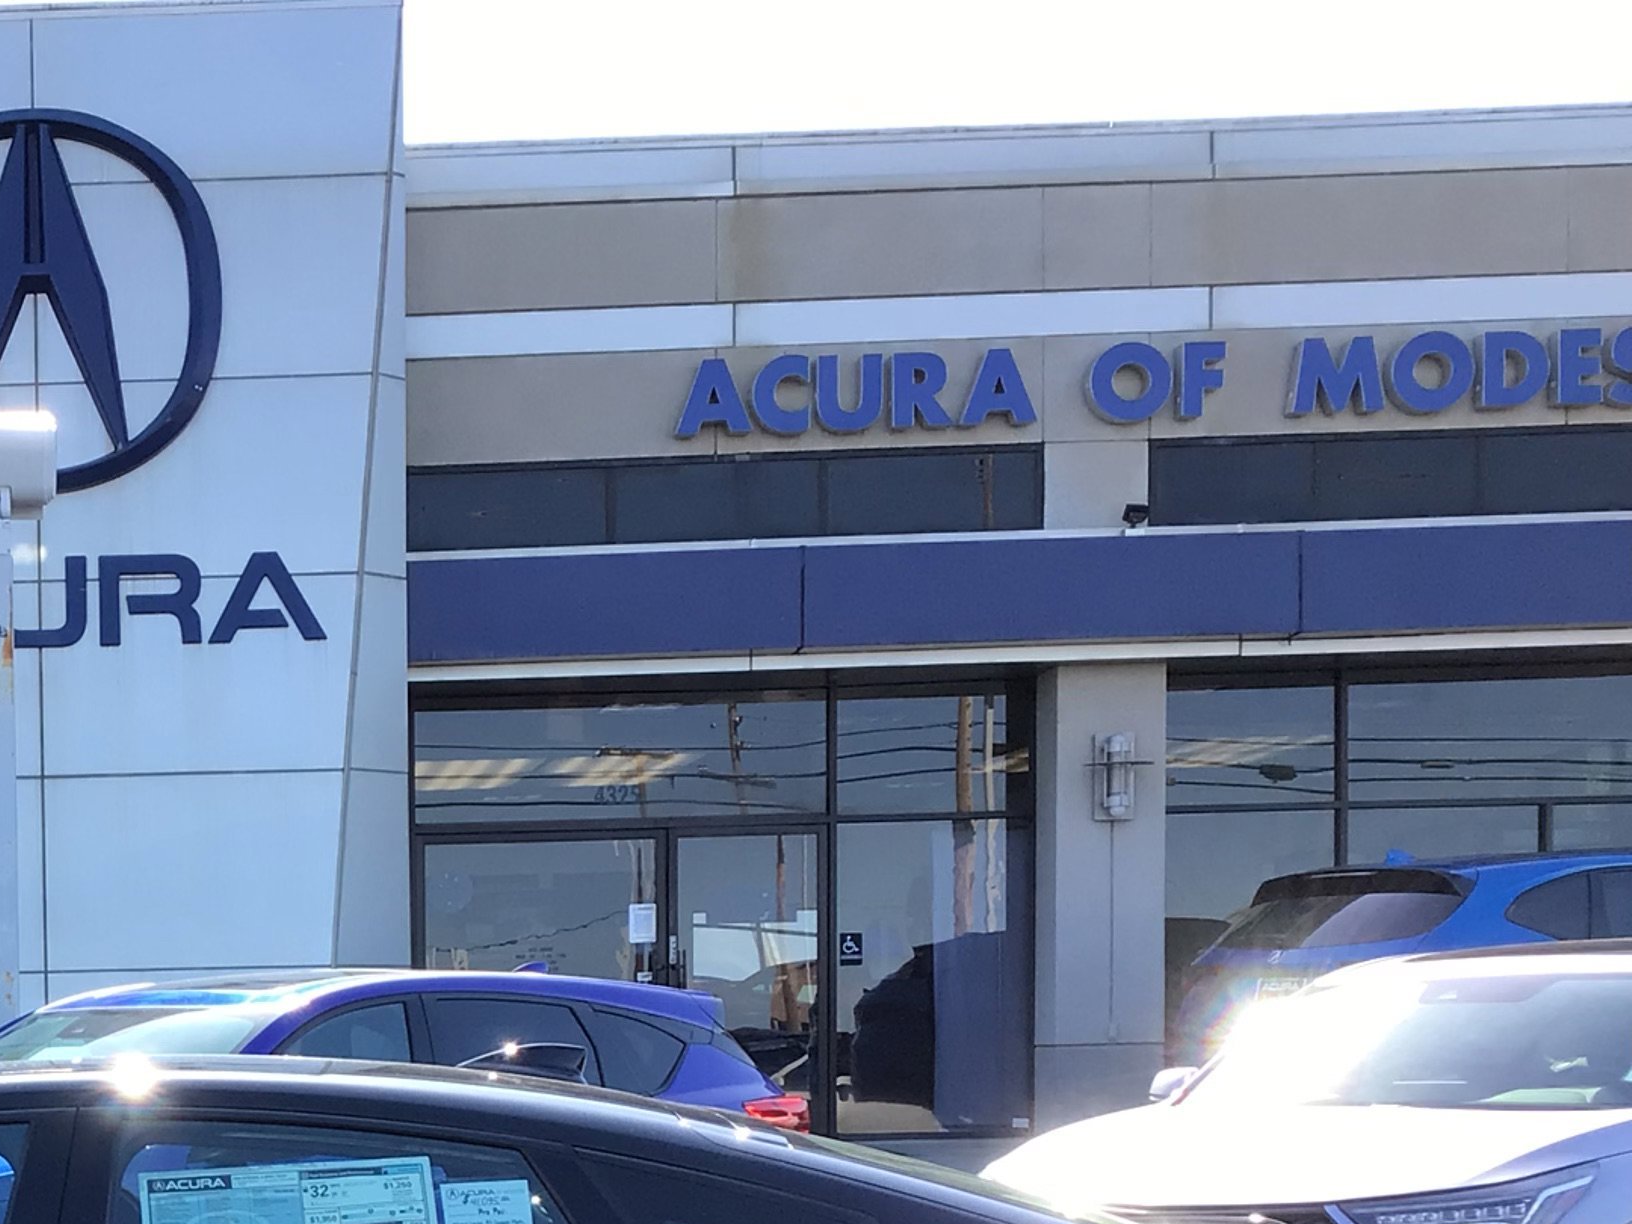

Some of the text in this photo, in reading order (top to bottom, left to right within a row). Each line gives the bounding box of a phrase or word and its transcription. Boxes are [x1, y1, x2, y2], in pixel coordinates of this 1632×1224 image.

[674, 348, 1038, 438] ACURA
[1086, 340, 1227, 424] OF
[166, 1178, 225, 1190] ACURA
[309, 1184, 329, 1198] 32
